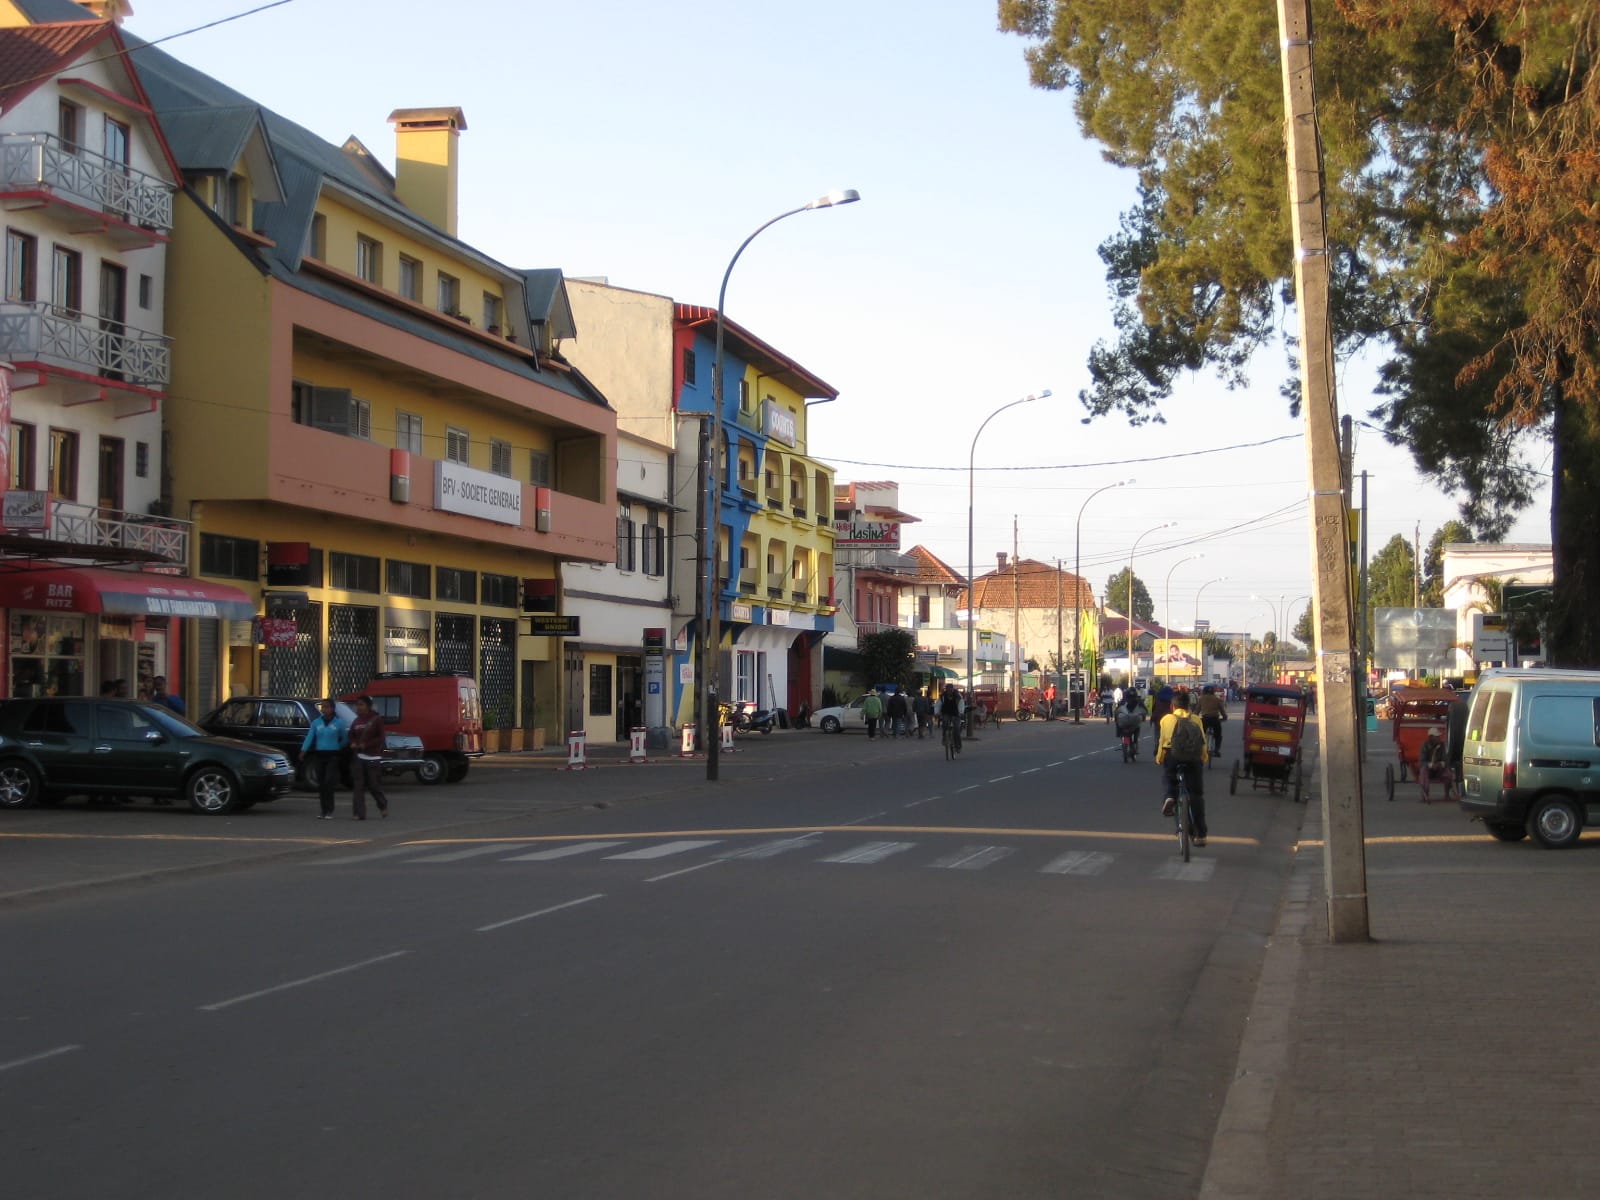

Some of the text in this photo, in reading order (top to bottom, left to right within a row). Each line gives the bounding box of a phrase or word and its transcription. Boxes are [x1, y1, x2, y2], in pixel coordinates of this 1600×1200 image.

[442, 477, 456, 496] BFV
[461, 481, 488, 504] SOCIETE
[488, 488, 520, 511] GENERALE
[48, 584, 73, 598] BAR
[45, 598, 73, 608] RITZ
